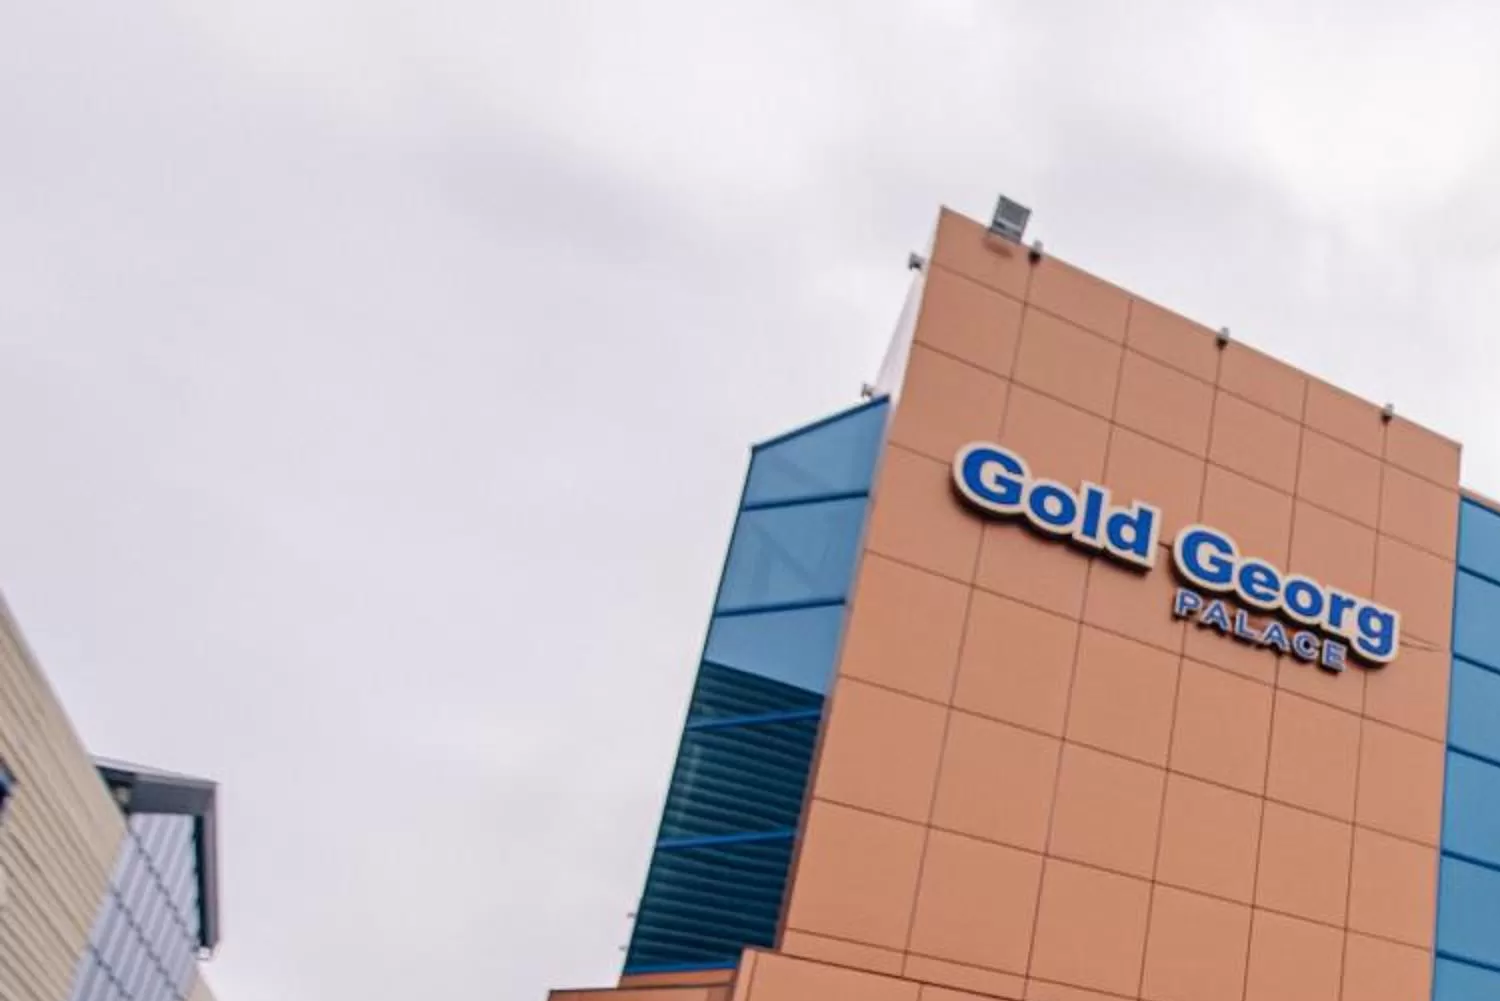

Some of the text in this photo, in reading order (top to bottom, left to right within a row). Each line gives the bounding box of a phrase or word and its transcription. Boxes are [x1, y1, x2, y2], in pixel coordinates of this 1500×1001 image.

[956, 443, 1399, 660] Gold Georg
[1173, 589, 1347, 672] PALACE
